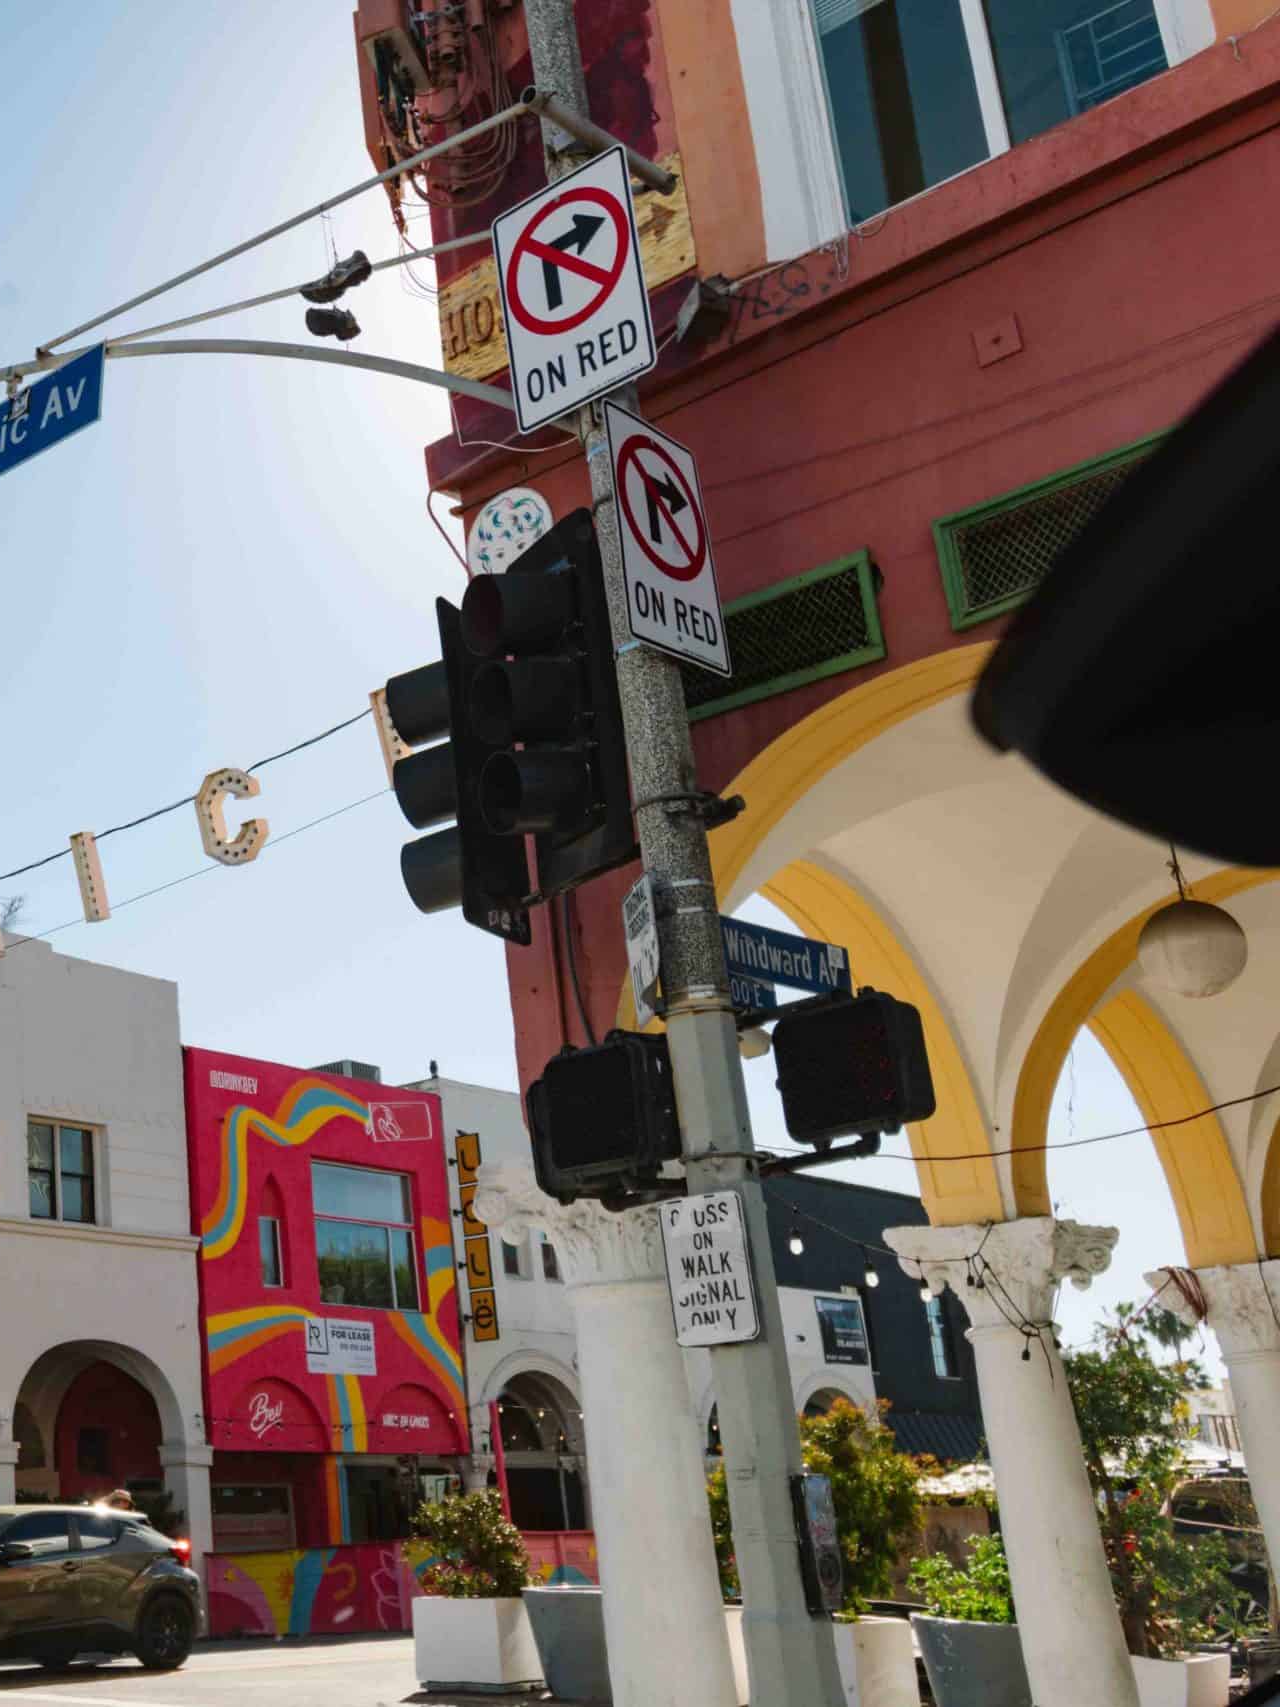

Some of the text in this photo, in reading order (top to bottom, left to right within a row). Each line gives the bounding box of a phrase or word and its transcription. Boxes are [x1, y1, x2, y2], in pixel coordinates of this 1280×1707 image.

[447, 295, 505, 361] HO
[526, 354, 567, 403] ON
[576, 319, 637, 377] RED
[635, 580, 718, 646] ON RED
[723, 926, 812, 981] Windward
[681, 1251, 732, 1279] WALK
[693, 1231, 713, 1250] ON
[331, 1329, 371, 1341] FOR LEASE
